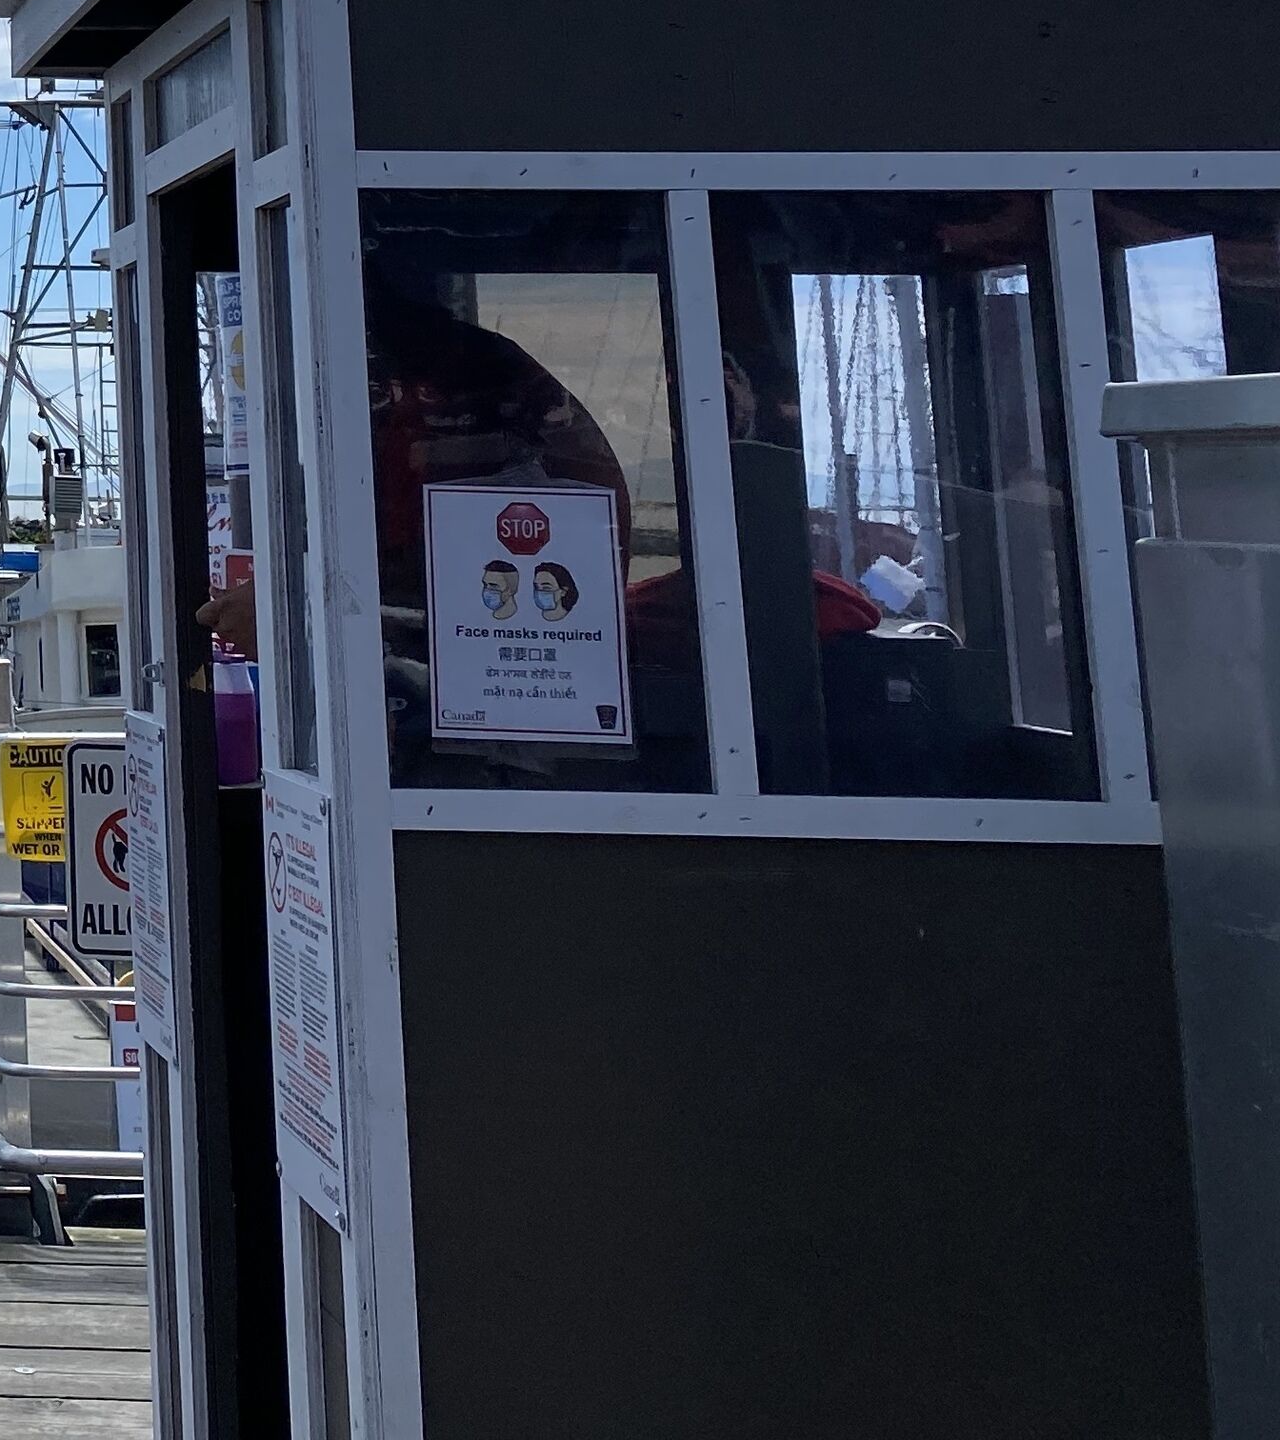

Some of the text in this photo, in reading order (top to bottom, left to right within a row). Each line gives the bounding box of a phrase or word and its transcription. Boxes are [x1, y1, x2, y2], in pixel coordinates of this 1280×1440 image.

[500, 519, 545, 539] STOP
[455, 625, 602, 643] Face masks required
[9, 748, 64, 764] CAUTIO
[80, 763, 115, 795] NO
[11, 843, 61, 856] WET OR
